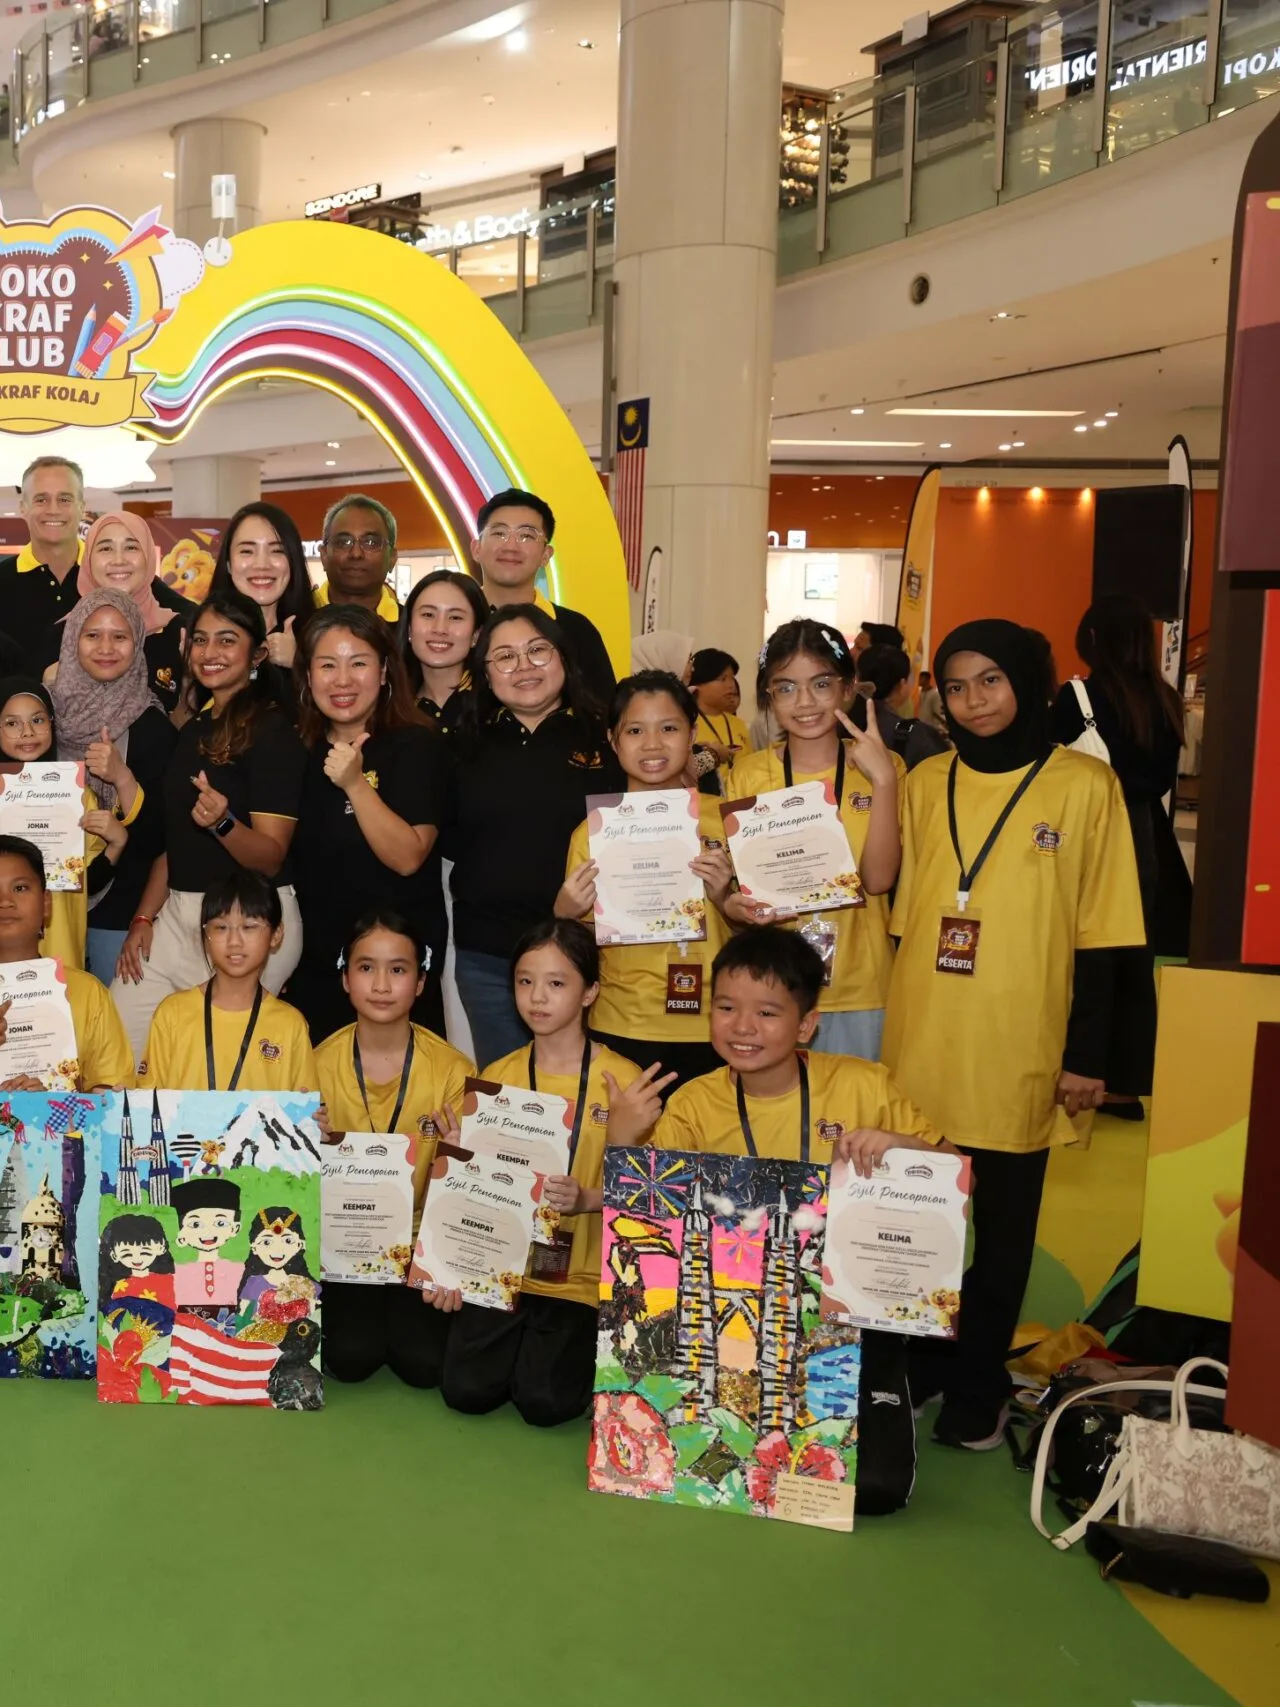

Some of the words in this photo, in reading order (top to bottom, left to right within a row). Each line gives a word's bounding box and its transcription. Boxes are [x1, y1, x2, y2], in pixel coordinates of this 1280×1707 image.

[453, 220, 472, 245] &
[46, 386, 100, 406] KOLAJ
[776, 848, 805, 859] KELIMA
[938, 956, 973, 970] PESERTA
[667, 999, 699, 1009] PESERTA
[8, 1025, 34, 1034] JOHAN
[476, 1112, 498, 1126] Sijil
[500, 1116, 556, 1138] Pencapaian
[496, 1153, 530, 1167] KEEMPAT
[444, 1176, 467, 1191] Sijil
[469, 1182, 522, 1208] Pencapaian
[879, 1185, 948, 1205] Pencapaian
[342, 1203, 377, 1211] KEEMPAT
[461, 1217, 495, 1234] KEEMPAT
[877, 1232, 912, 1244] KELIMA
